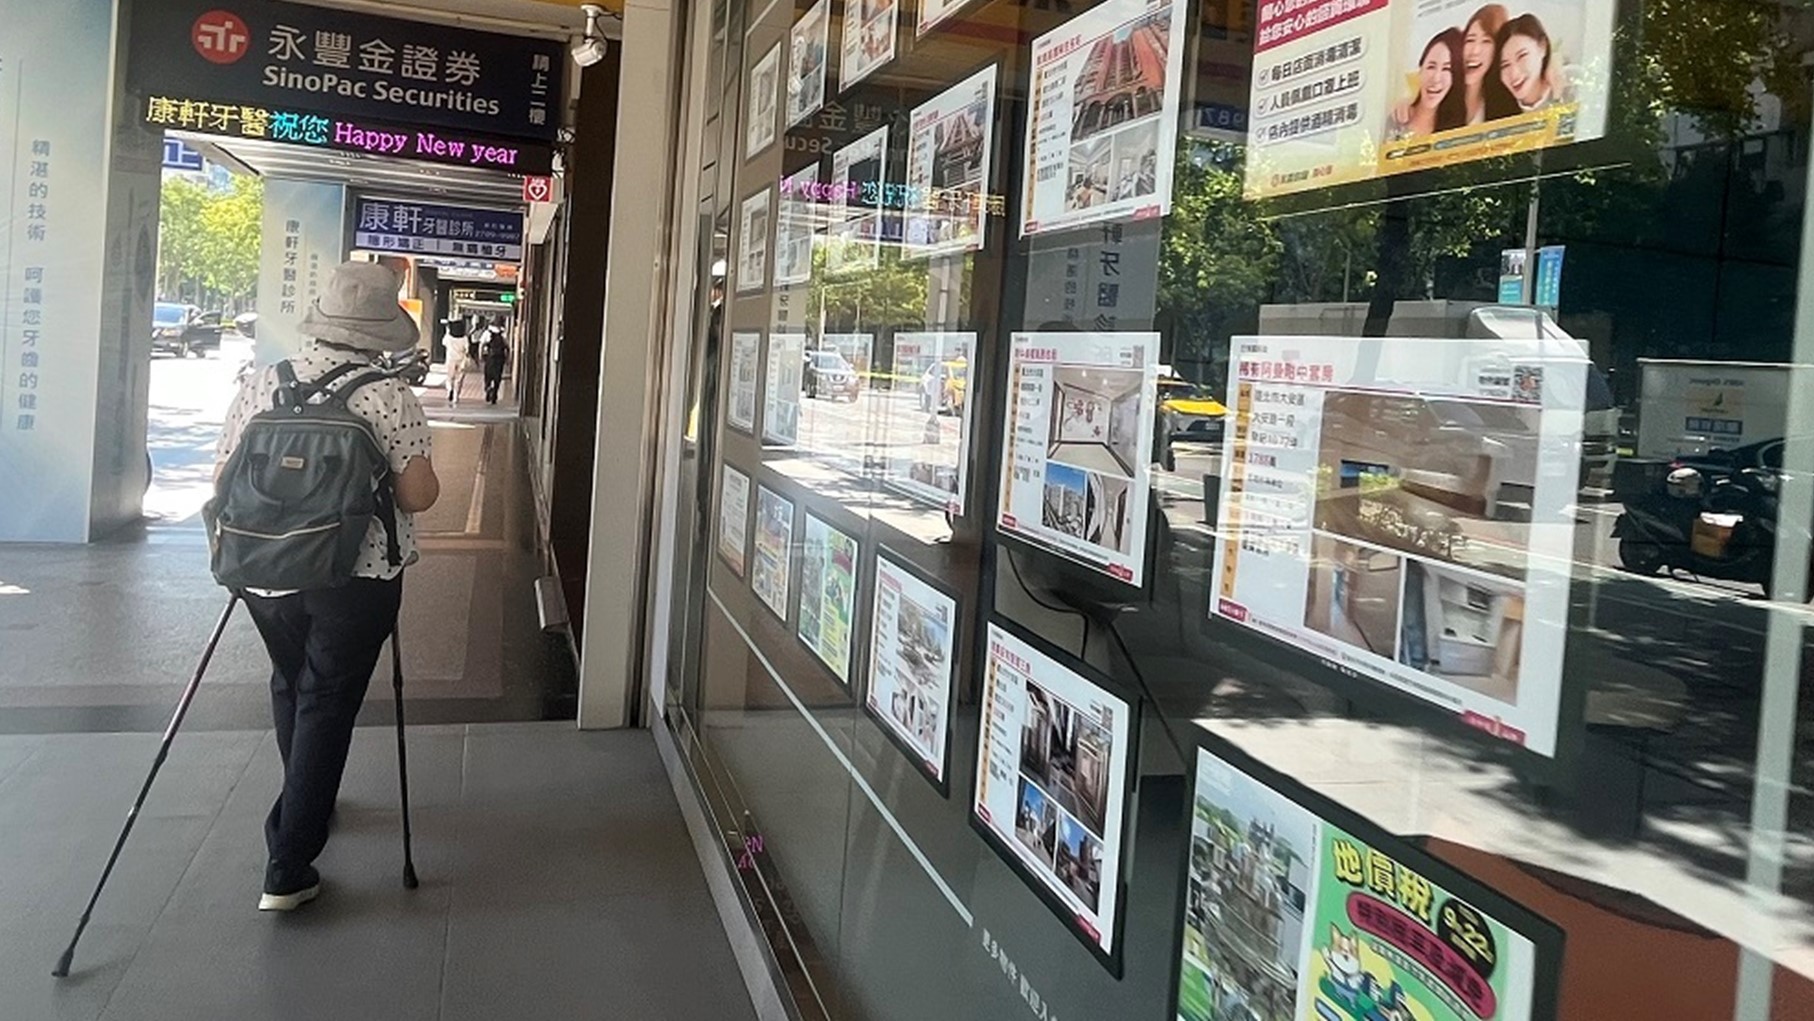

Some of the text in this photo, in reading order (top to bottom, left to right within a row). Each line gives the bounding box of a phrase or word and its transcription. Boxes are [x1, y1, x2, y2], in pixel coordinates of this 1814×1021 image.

[262, 65, 500, 116] SinoPac Securities
[268, 24, 481, 87] 永豐金證券
[146, 96, 518, 166] 康軒牙醫祝您 Happy New year
[26, 139, 51, 241] 精湛的技術
[359, 202, 475, 238] 康軒牙醫診所
[16, 266, 45, 430] 呵護您牙齒的健康
[1333, 839, 1435, 924] 地價稅
